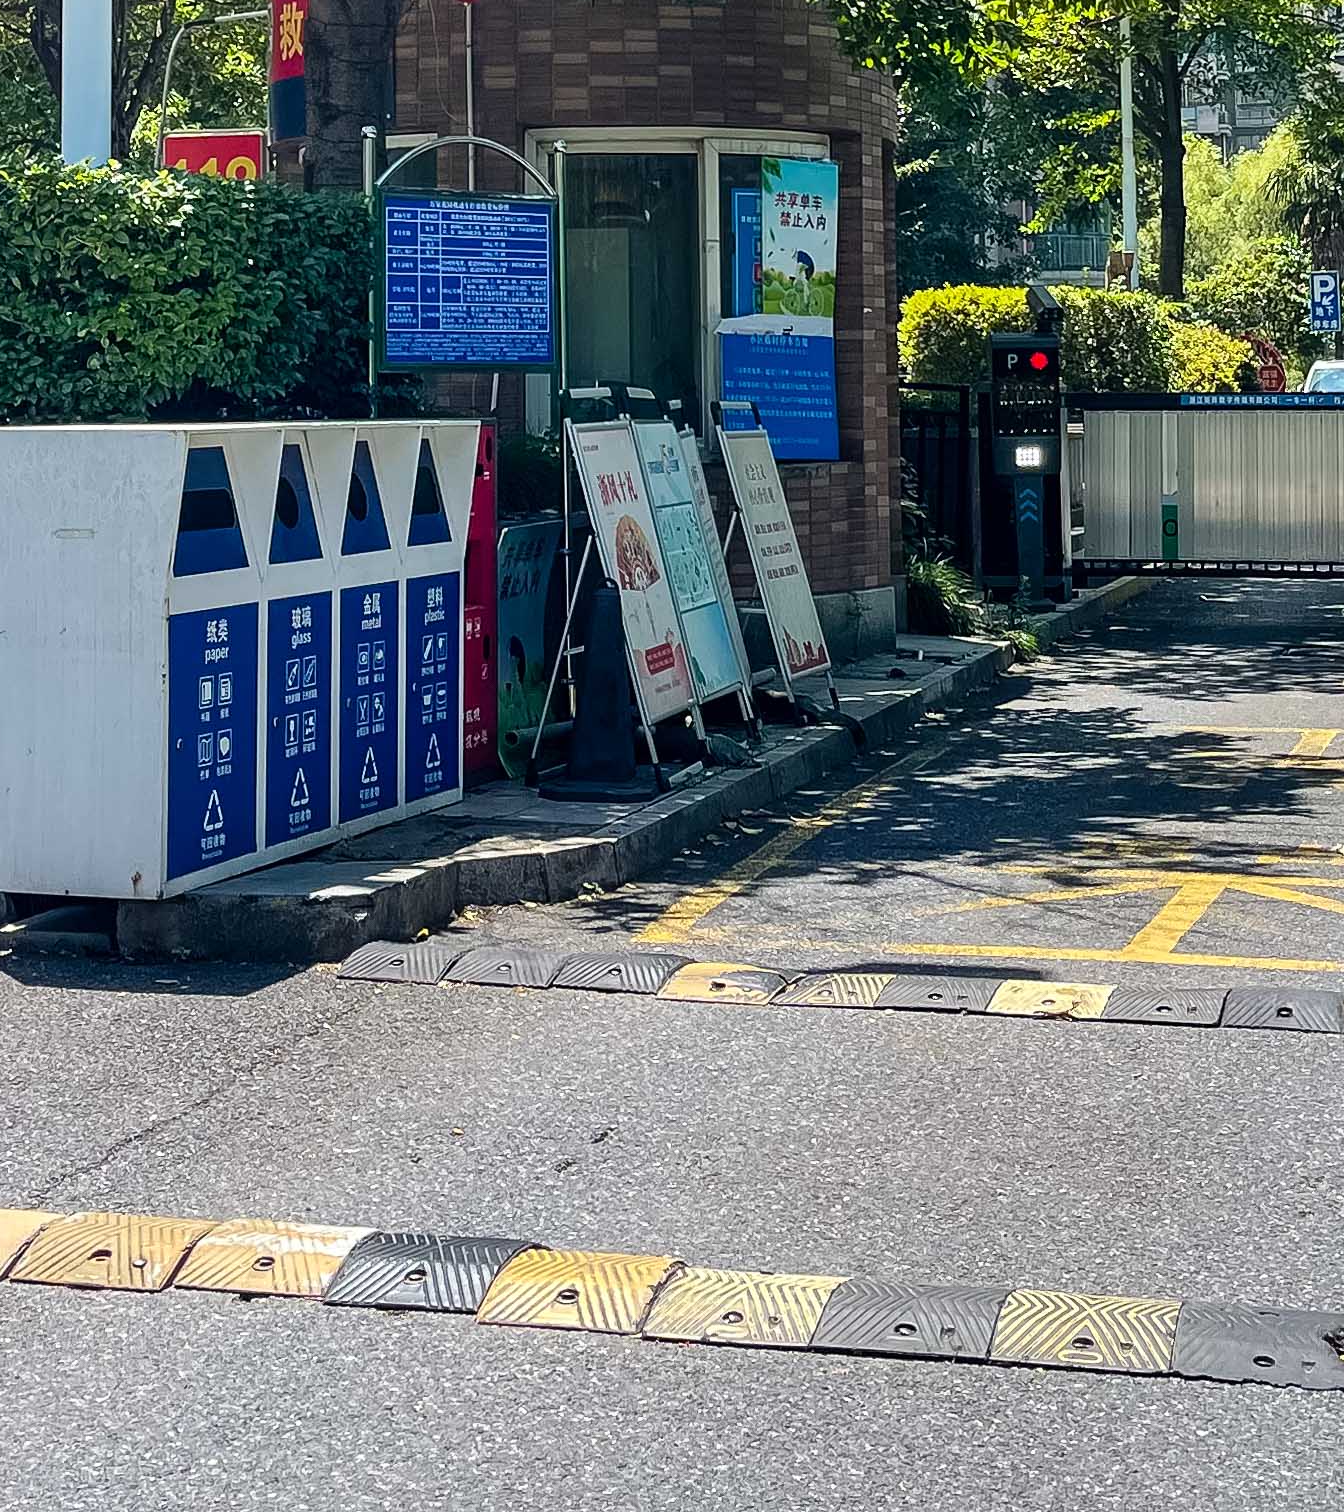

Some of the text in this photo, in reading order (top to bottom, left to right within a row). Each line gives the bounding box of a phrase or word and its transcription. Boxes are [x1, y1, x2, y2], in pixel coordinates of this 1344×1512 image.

[774, 192, 823, 211] 共享单车
[779, 211, 827, 231] 禁止入内
[1313, 274, 1336, 303] P
[1007, 354, 1019, 369] P
[363, 592, 381, 615] 金属
[426, 586, 443, 608] 塑料
[291, 606, 312, 629] 玻璃
[361, 614, 382, 630] metal
[424, 607, 445, 626] plastic
[206, 618, 229, 643] 纸类
[291, 630, 312, 649] glass
[205, 646, 229, 664] paper
